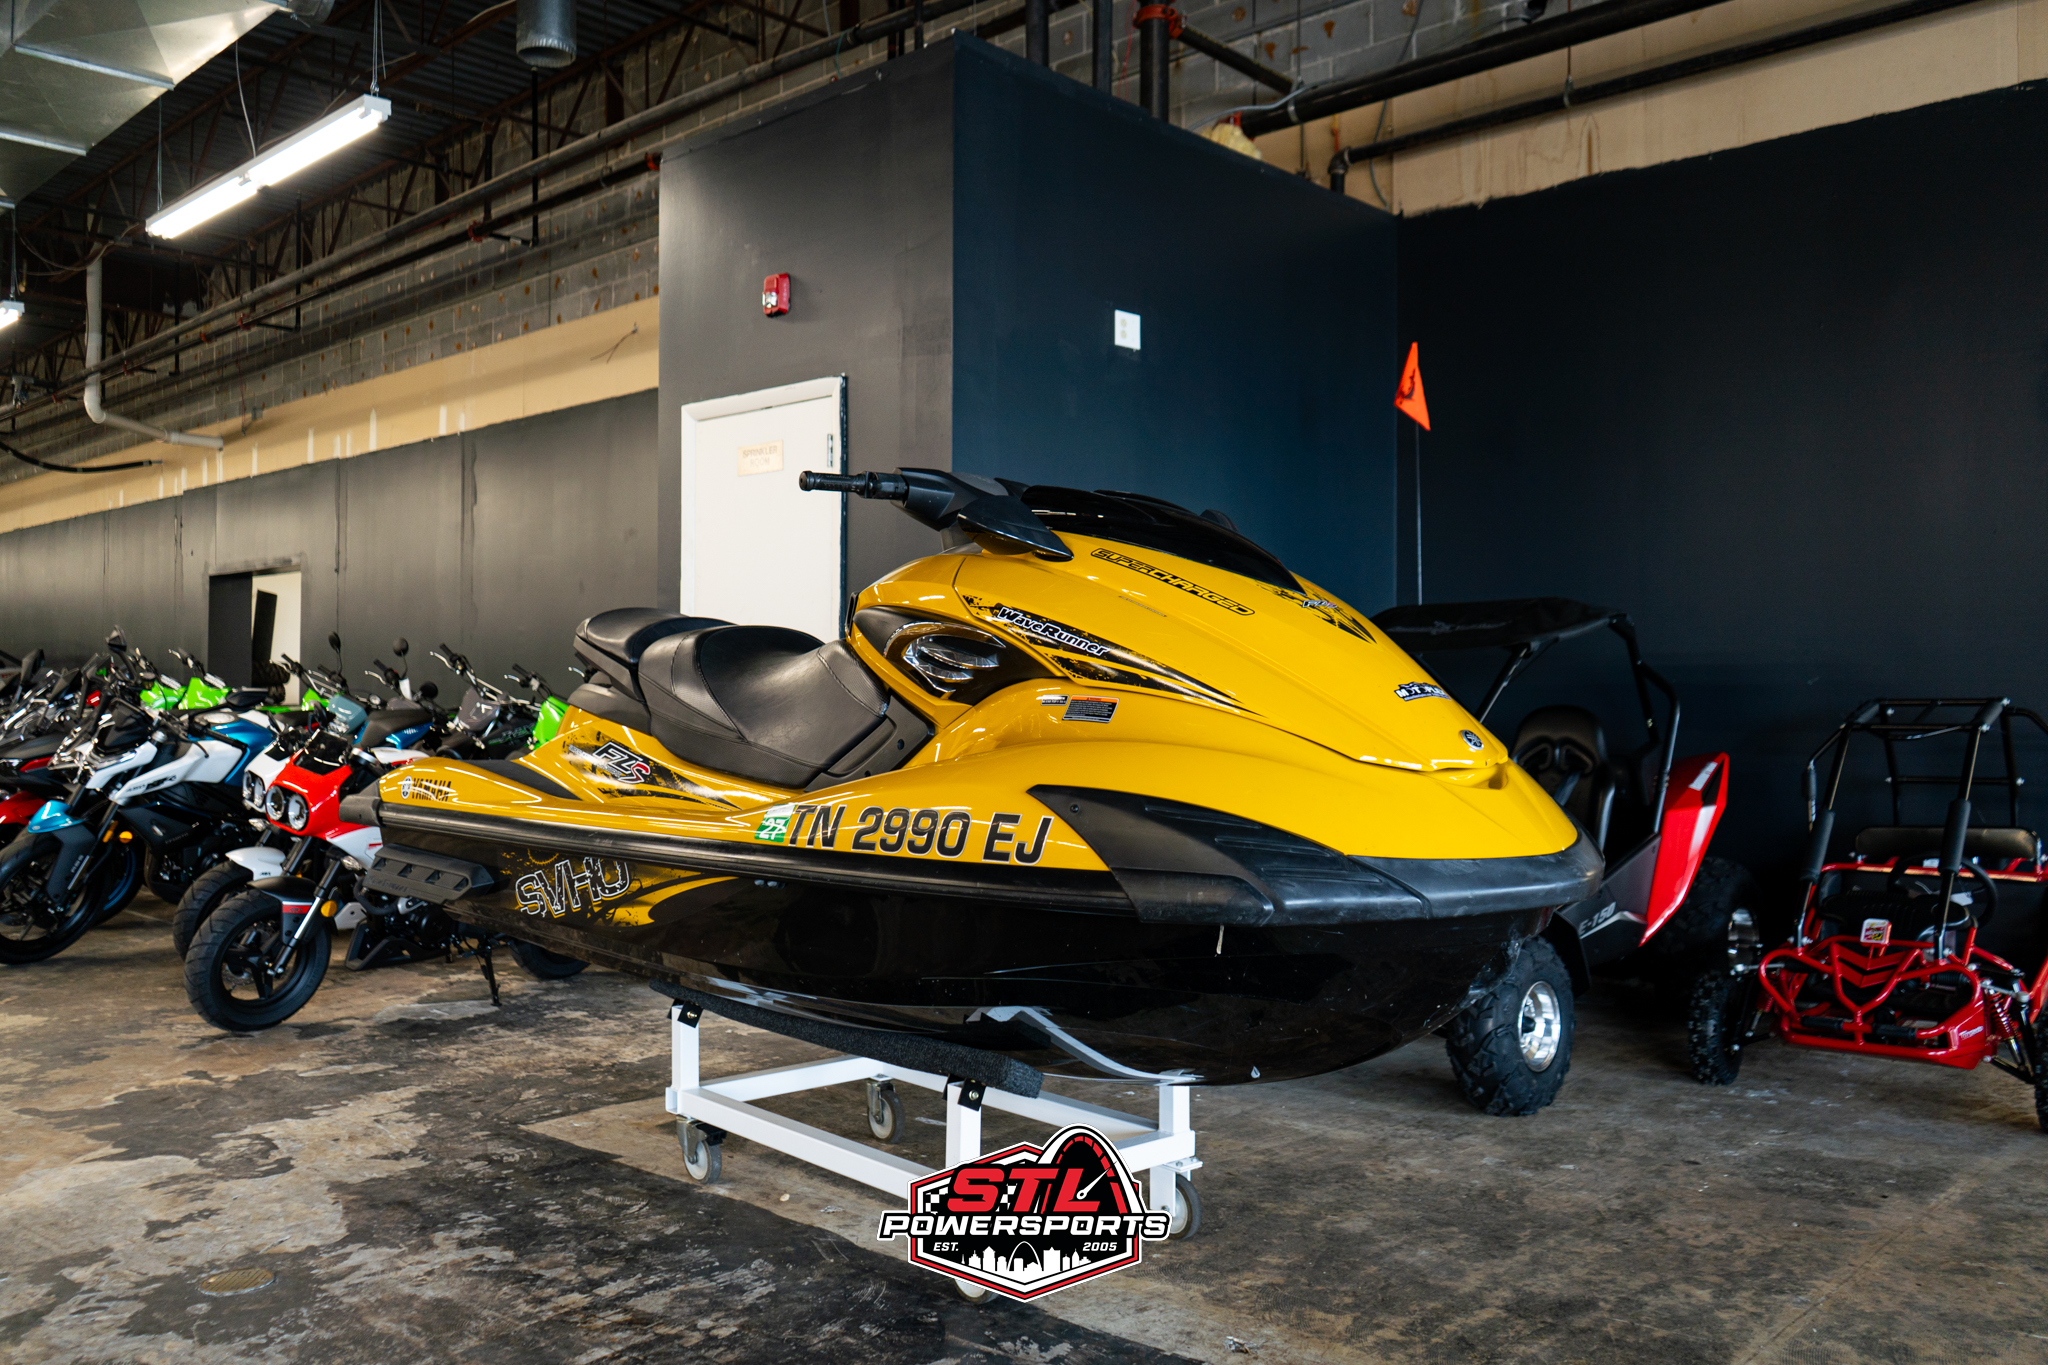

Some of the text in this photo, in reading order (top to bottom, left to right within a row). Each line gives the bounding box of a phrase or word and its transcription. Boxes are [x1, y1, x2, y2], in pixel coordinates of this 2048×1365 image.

[1094, 549, 1253, 615] SUPERCHARGED
[997, 606, 1109, 656] WaveRunner
[411, 777, 452, 802] YAMAHA
[788, 804, 1054, 865] TN 2990 EJ
